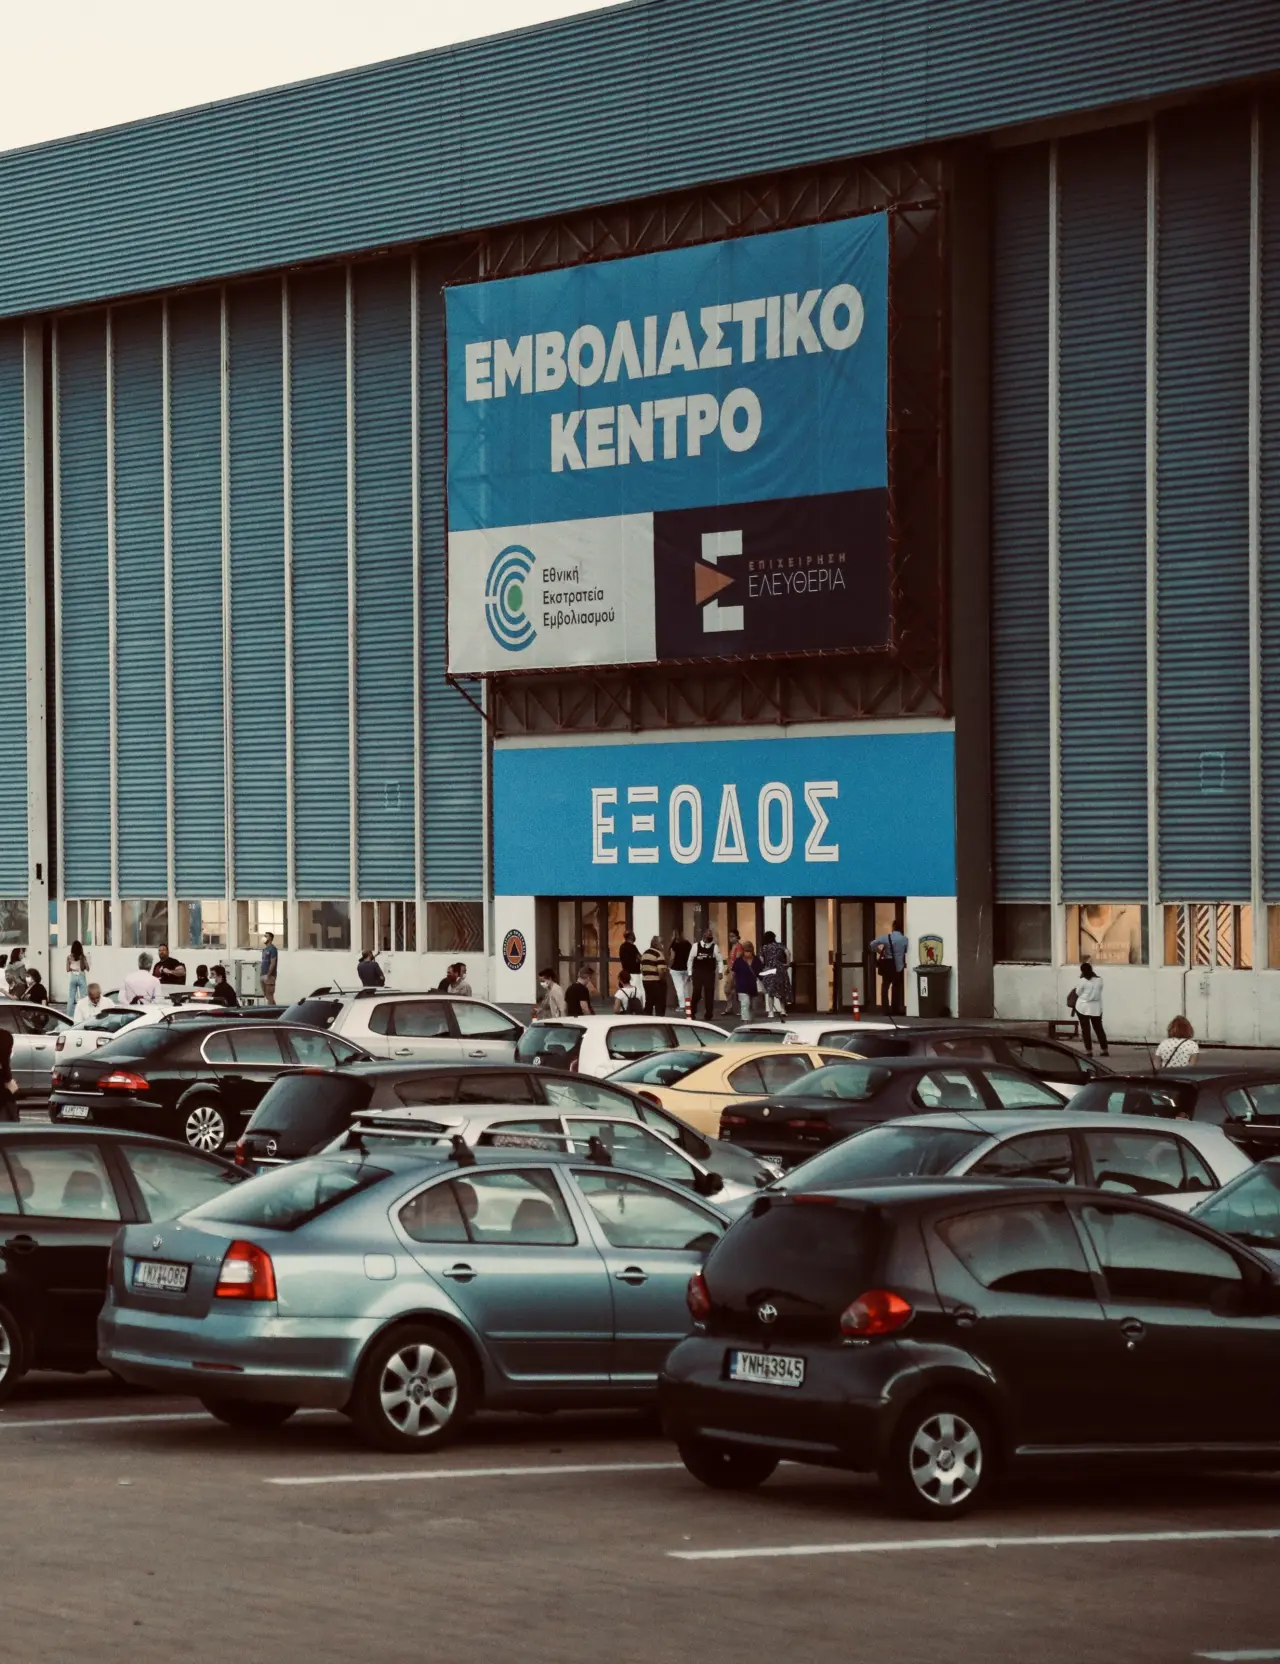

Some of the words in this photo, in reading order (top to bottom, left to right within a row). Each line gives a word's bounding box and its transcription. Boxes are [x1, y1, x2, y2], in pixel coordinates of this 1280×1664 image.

[465, 283, 865, 402] ΕΜΒΟΛΙΑΣΤΙΚΟ
[551, 387, 762, 472] ΚΕΝΤΡΟ
[542, 565, 579, 584] Εθνική
[748, 552, 846, 571] ΕΠΙΧΕΙΡΗΣΗ
[748, 567, 846, 597] ΕΛΕΥΘΕΡΙΑ
[543, 586, 604, 607] Εκστρατεία
[543, 607, 615, 629] Εμβολιασμού
[591, 780, 839, 864] ΕΞΟΔΟΣ
